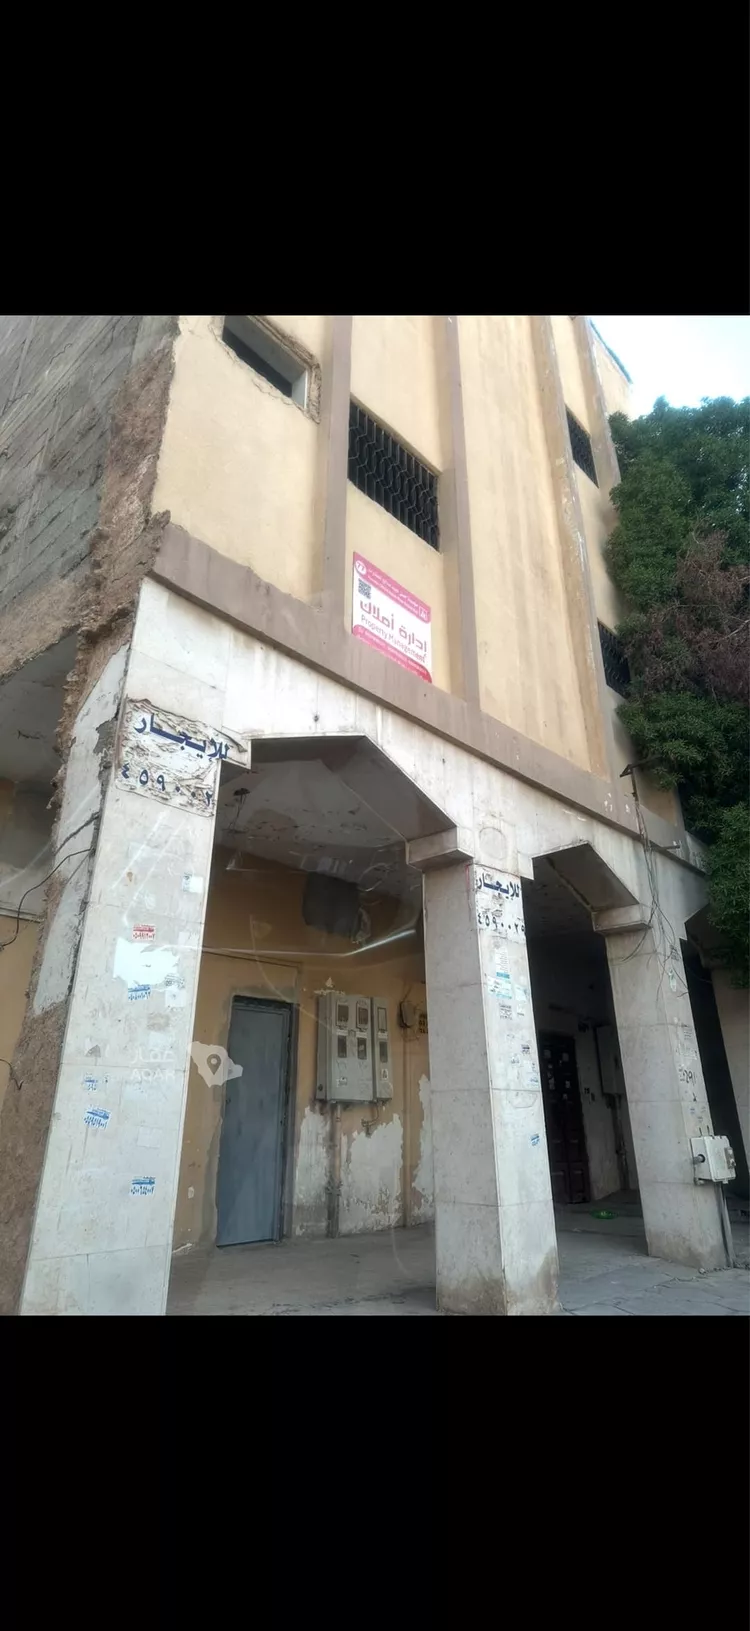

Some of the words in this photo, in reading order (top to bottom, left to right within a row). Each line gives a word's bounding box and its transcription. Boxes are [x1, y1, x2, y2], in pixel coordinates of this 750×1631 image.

[360, 600, 394, 630] أملاك
[361, 613, 388, 640] Property
[388, 634, 426, 664] Management
